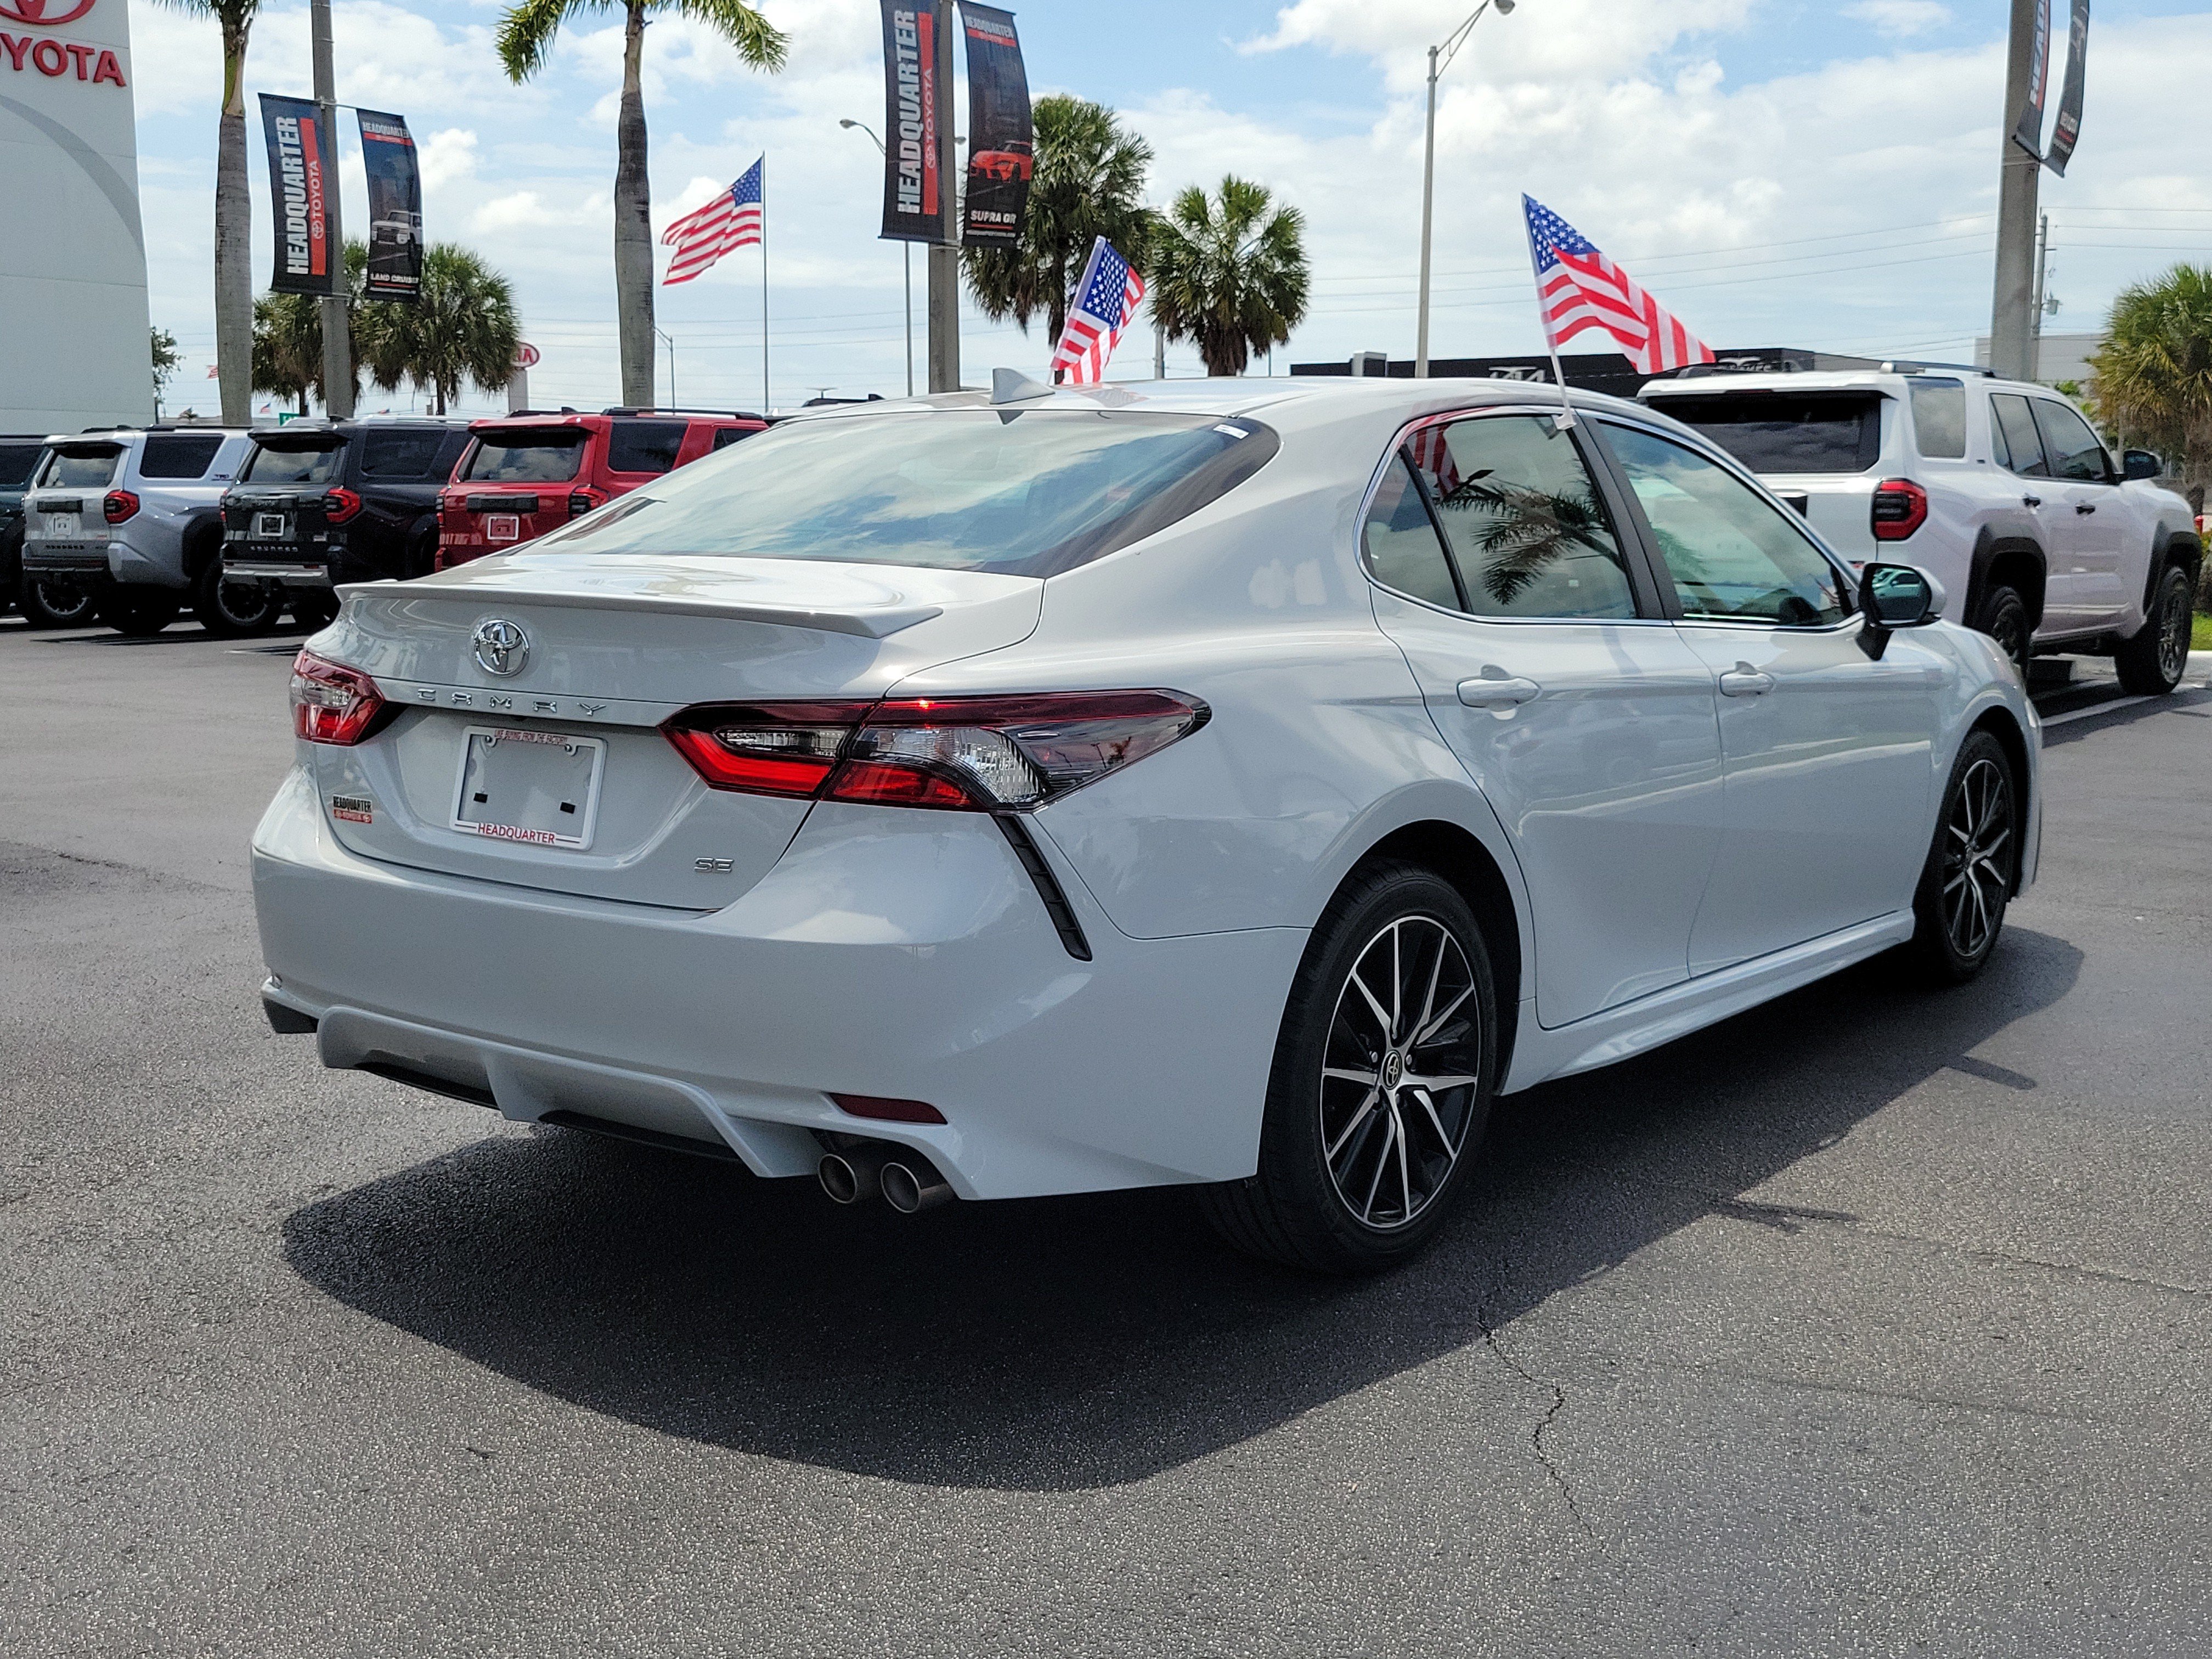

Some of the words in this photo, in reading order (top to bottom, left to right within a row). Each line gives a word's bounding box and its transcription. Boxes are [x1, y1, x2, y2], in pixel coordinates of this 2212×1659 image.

[0, 33, 127, 87] YOTA
[894, 10, 924, 214] HEADQUARTER
[924, 67, 934, 140] TOYOTA
[276, 117, 309, 275] HEADQUARTER
[309, 161, 323, 219] TOYOTA
[970, 210, 1002, 223] SUPRA
[1003, 212, 1017, 224] GR
[370, 273, 390, 281] LAND
[417, 689, 607, 716] CAMRY
[477, 822, 555, 844] HEADQUARTER
[694, 857, 734, 873] SE
